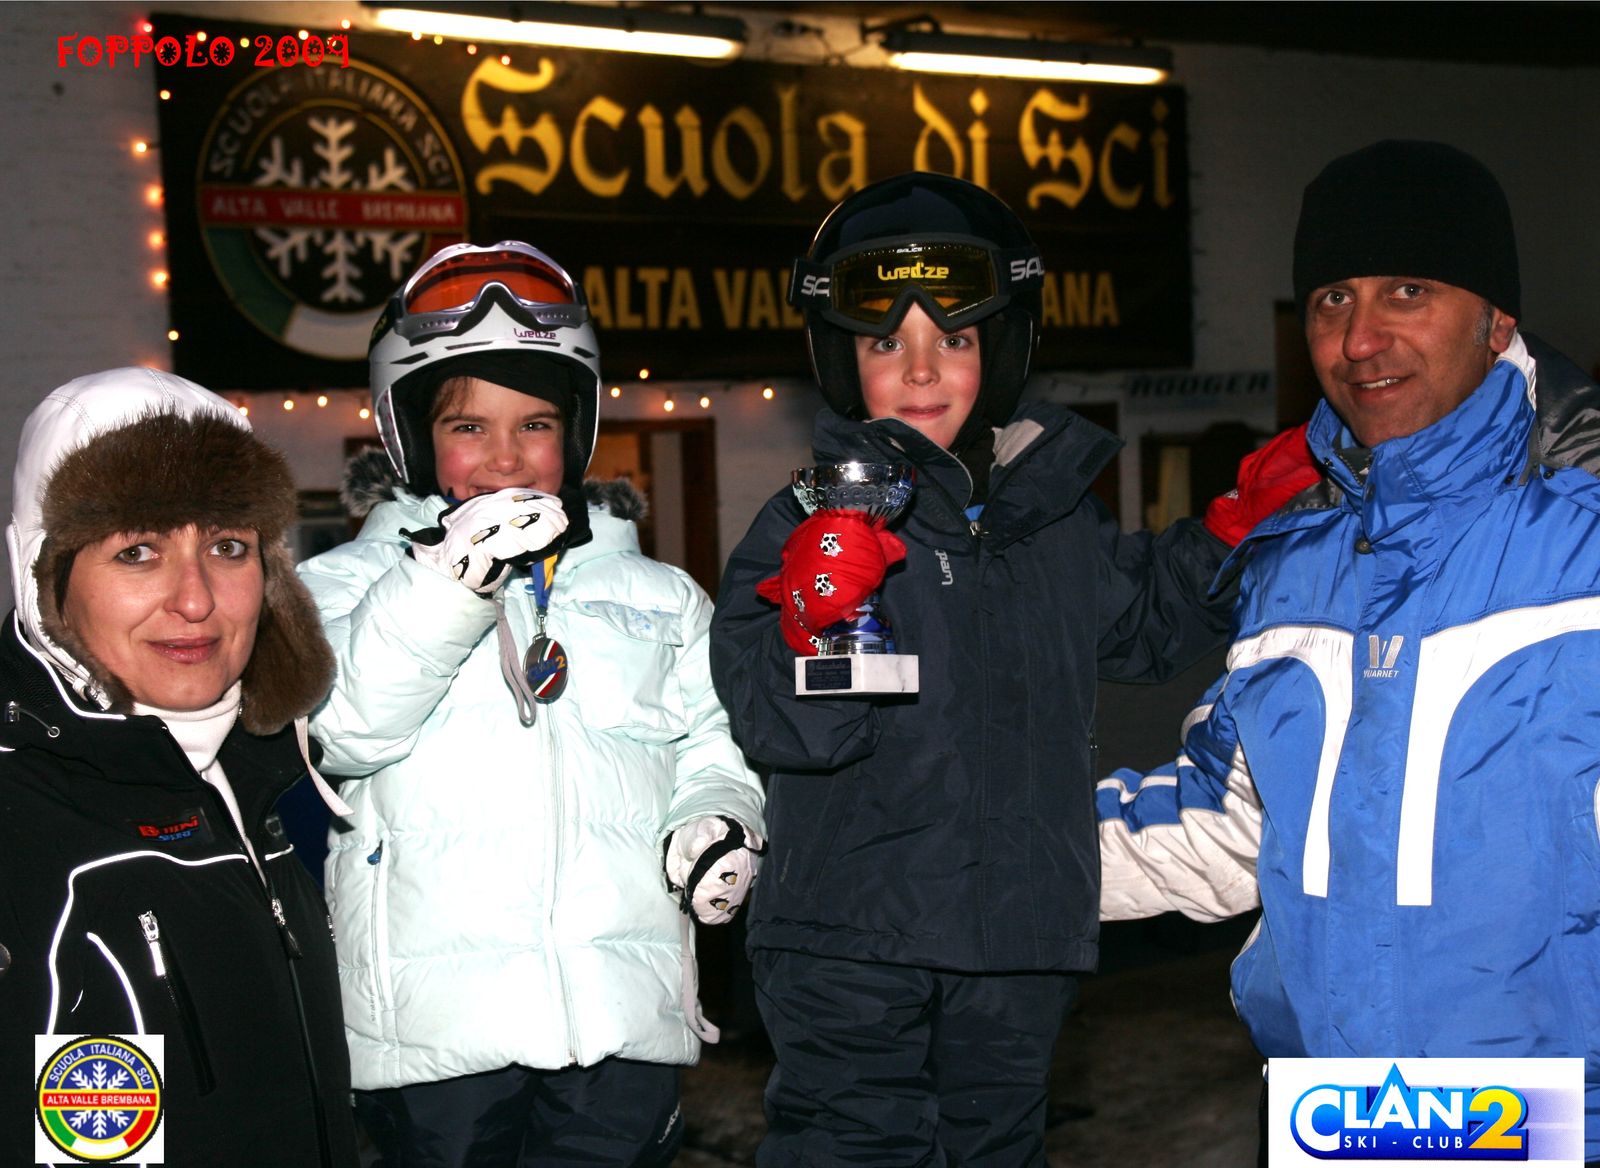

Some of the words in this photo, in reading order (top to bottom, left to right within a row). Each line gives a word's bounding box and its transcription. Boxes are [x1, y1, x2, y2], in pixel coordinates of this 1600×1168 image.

[210, 77, 294, 178] SCUOLA
[461, 56, 869, 201] Scuola
[913, 82, 989, 188] di
[1018, 88, 1174, 210] Sci
[211, 195, 267, 219] ALTA
[278, 196, 340, 220] VALLE
[583, 267, 701, 330] ALTA
[713, 267, 804, 330] VAL
[1041, 270, 1122, 328] ANA
